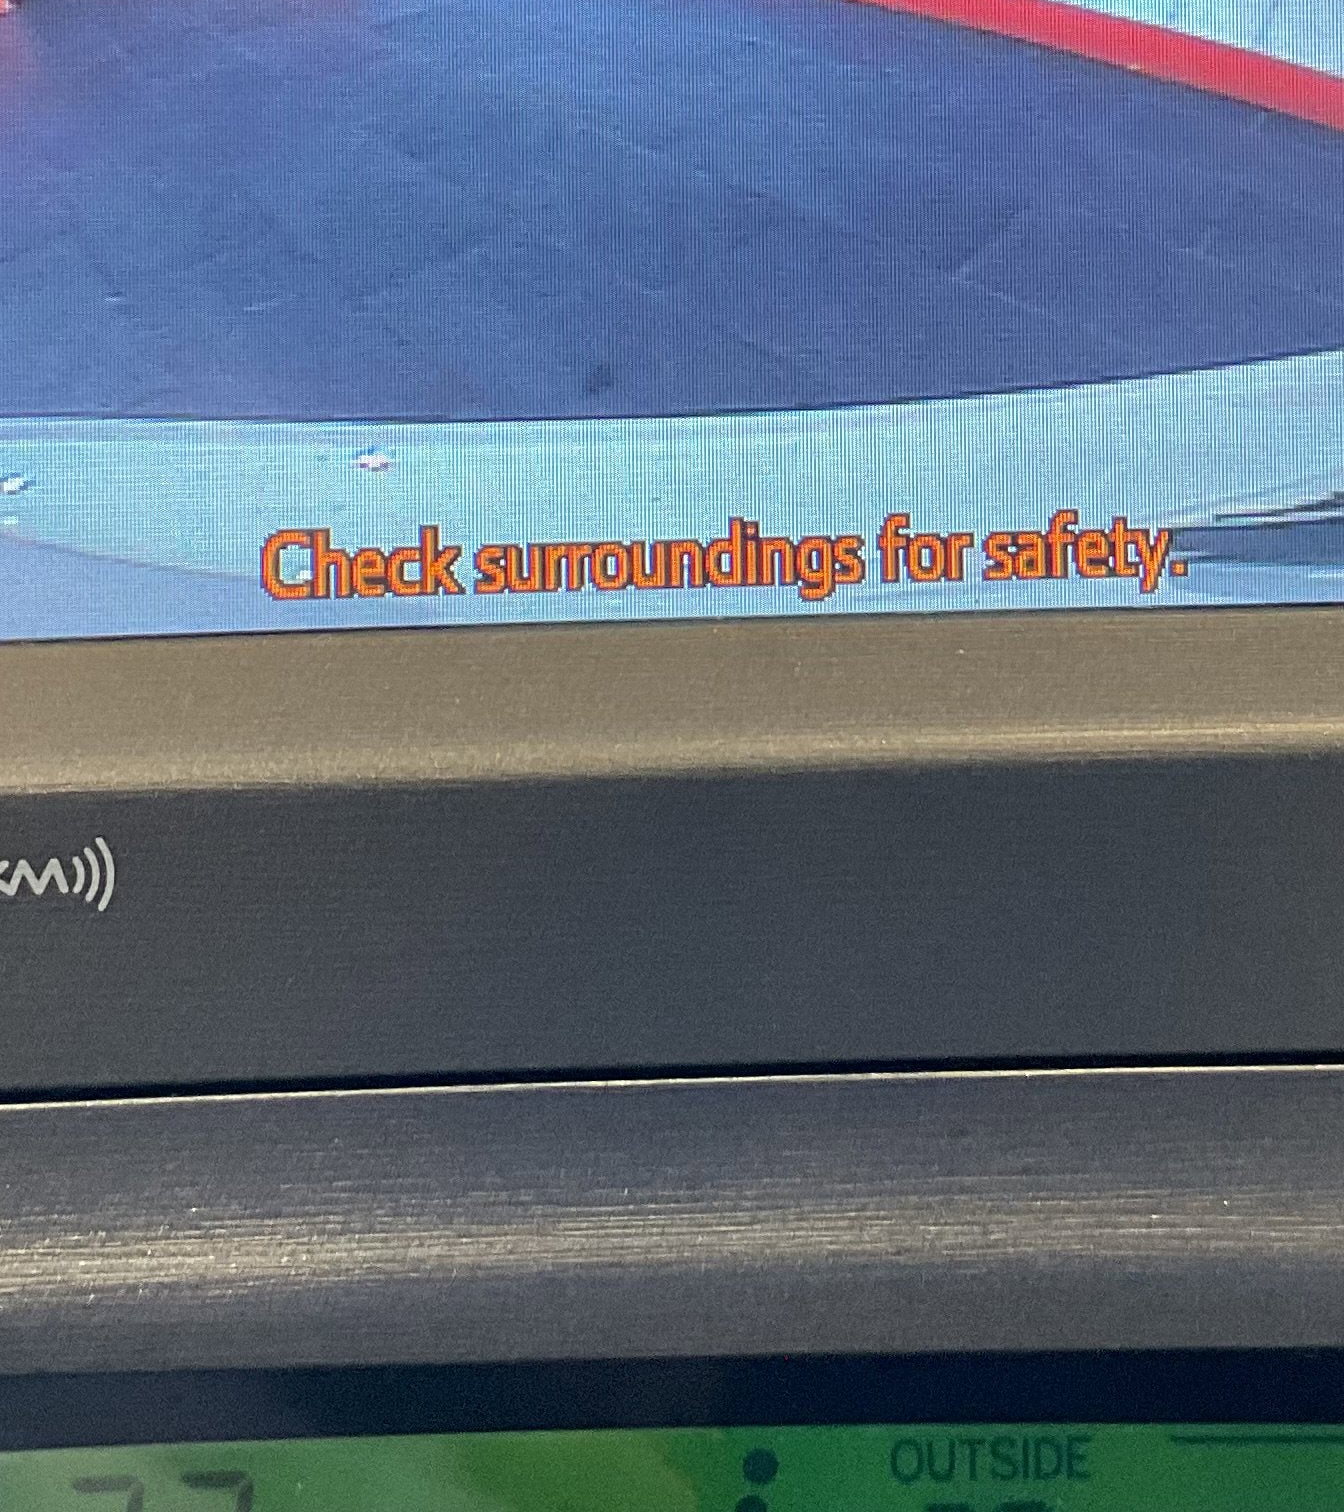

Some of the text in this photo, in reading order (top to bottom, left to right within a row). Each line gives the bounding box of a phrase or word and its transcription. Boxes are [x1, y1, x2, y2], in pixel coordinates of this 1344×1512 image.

[260, 508, 1190, 602] Check surroundings for safety.
[888, 1434, 1094, 1485] OUTSIDE
